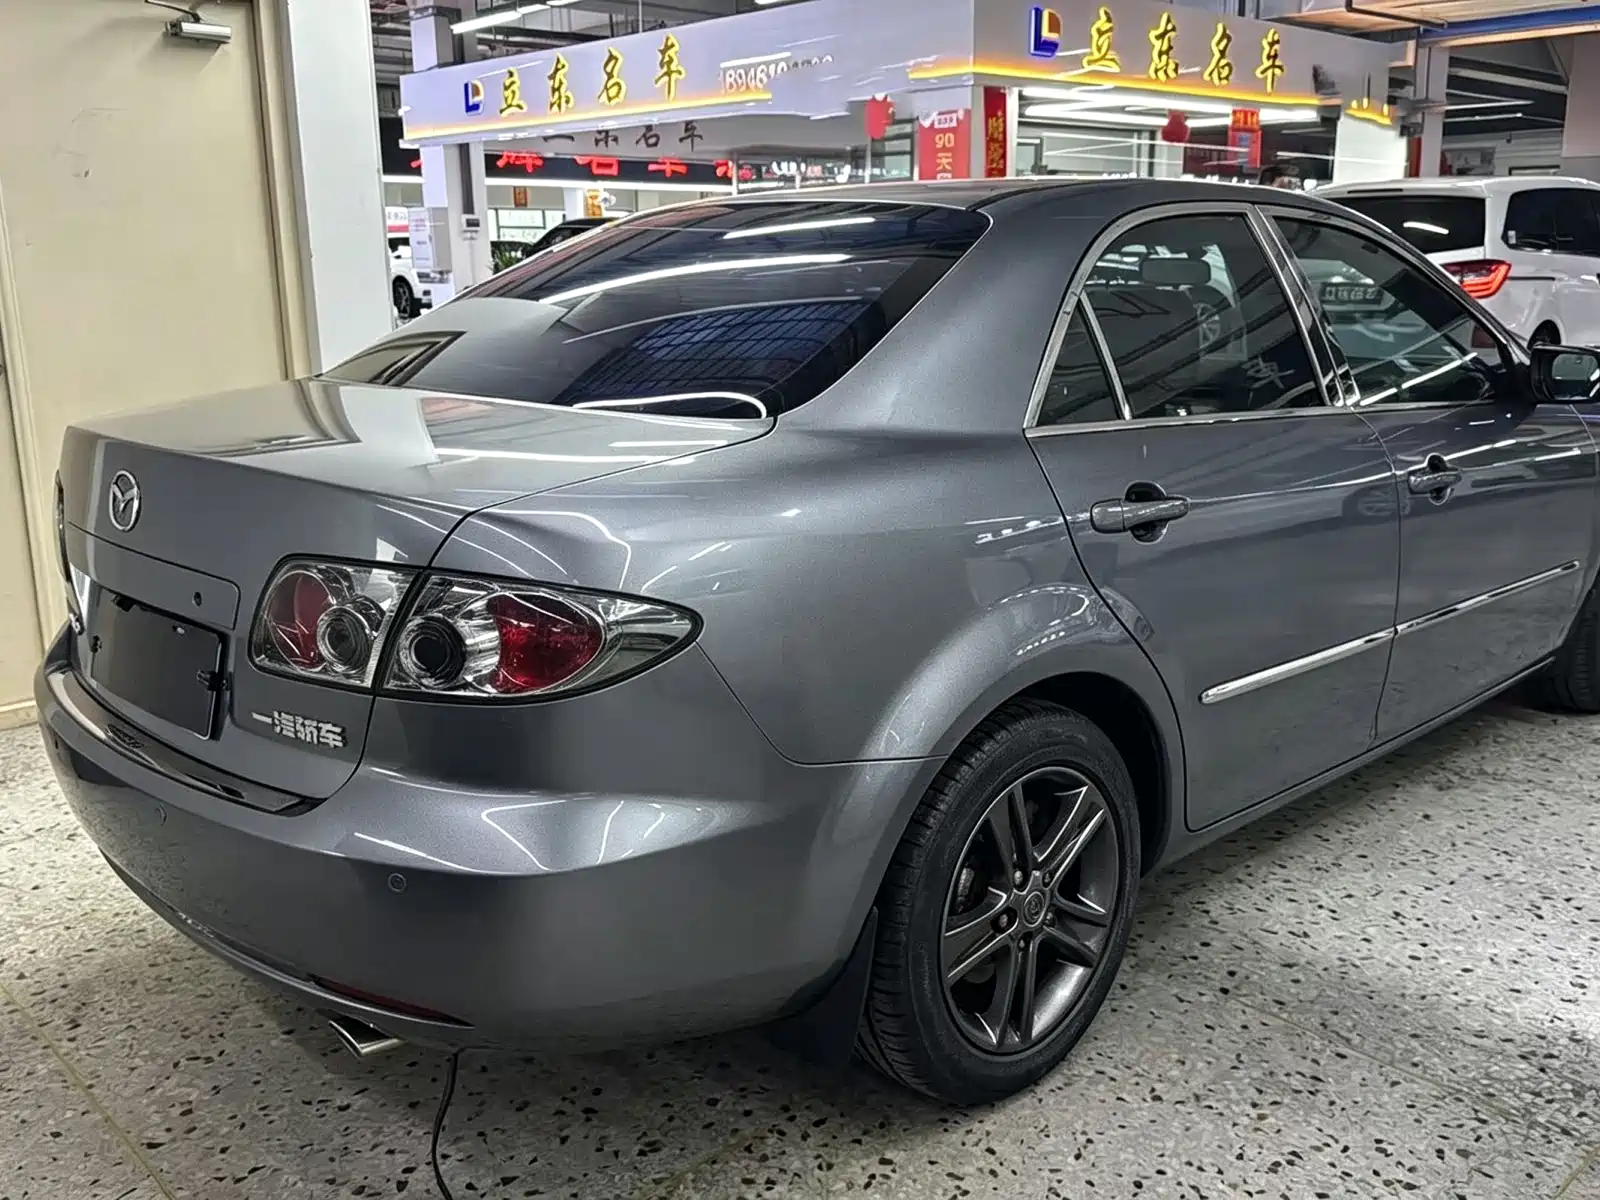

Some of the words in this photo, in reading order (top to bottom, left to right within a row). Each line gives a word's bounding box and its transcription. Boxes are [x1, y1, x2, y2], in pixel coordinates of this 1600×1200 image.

[499, 33, 686, 117] 立东名车
[1082, 7, 1285, 94] 立东名车
[251, 710, 345, 748] 一汽轿车
